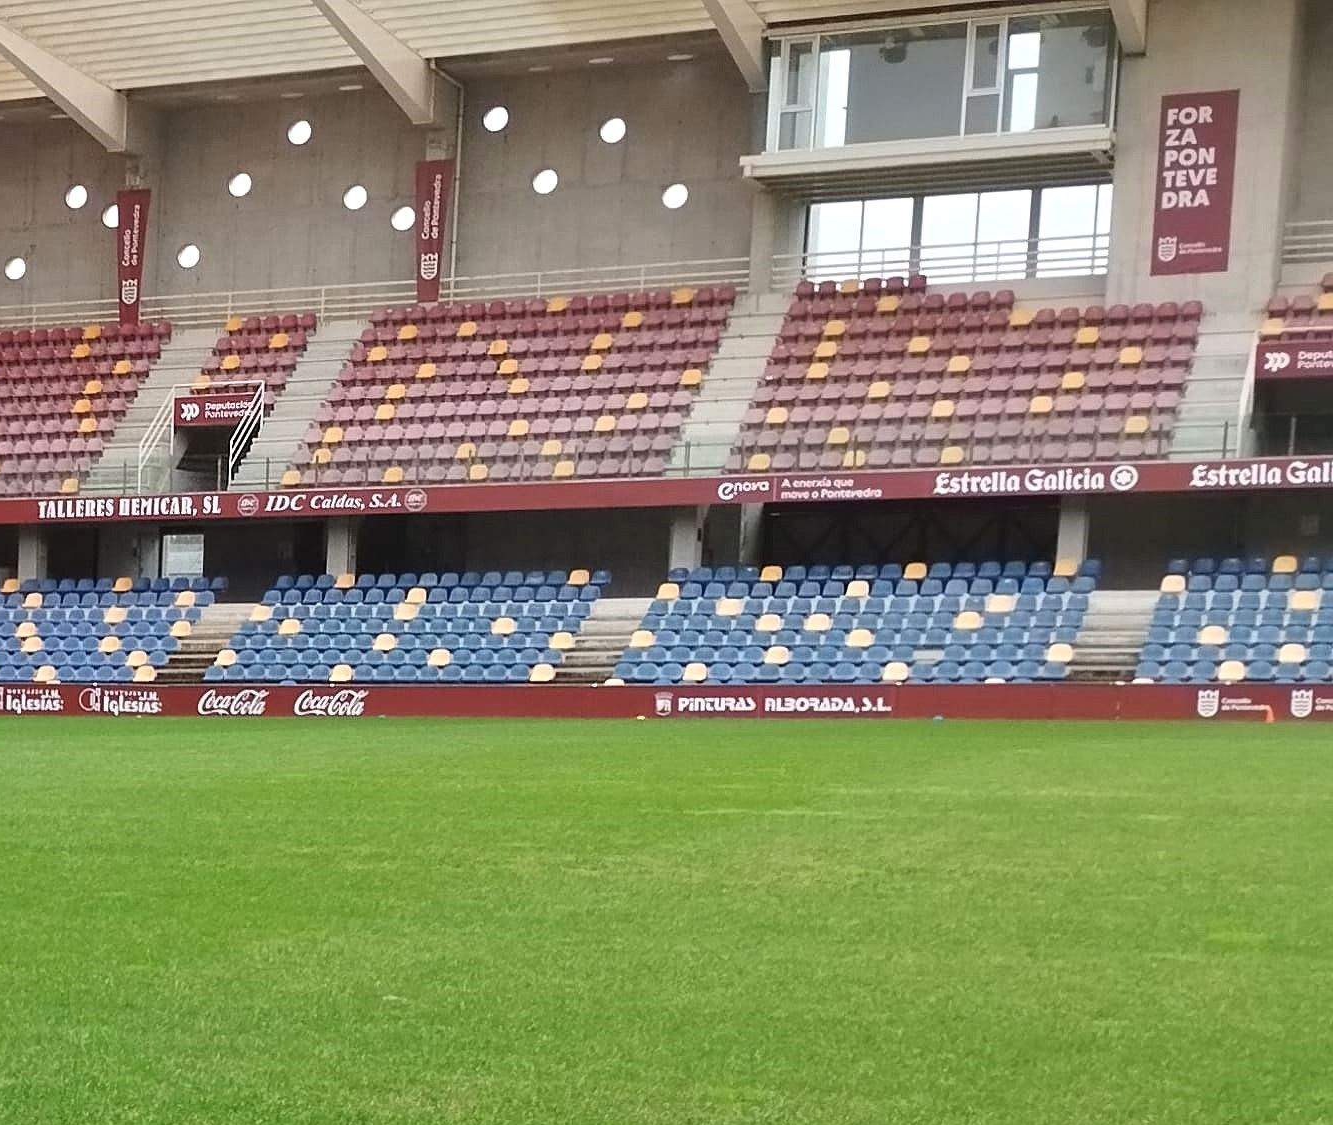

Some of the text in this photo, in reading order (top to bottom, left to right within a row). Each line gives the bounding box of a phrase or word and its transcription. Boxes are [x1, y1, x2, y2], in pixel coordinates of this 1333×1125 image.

[1167, 106, 1213, 126] FOR
[1165, 127, 1197, 147] ZA
[1164, 147, 1215, 167] PON
[1163, 168, 1218, 188] TEVE
[1161, 189, 1210, 209] DRA
[834, 478, 854, 488] que
[933, 468, 1105, 496] Estrella Galicia
[1189, 463, 1283, 488] Estrella
[265, 492, 402, 512] IDC Caldas, S.A.
[821, 487, 883, 499] Pontevedra
[38, 499, 114, 519] TALLERES
[202, 495, 222, 514] SL
